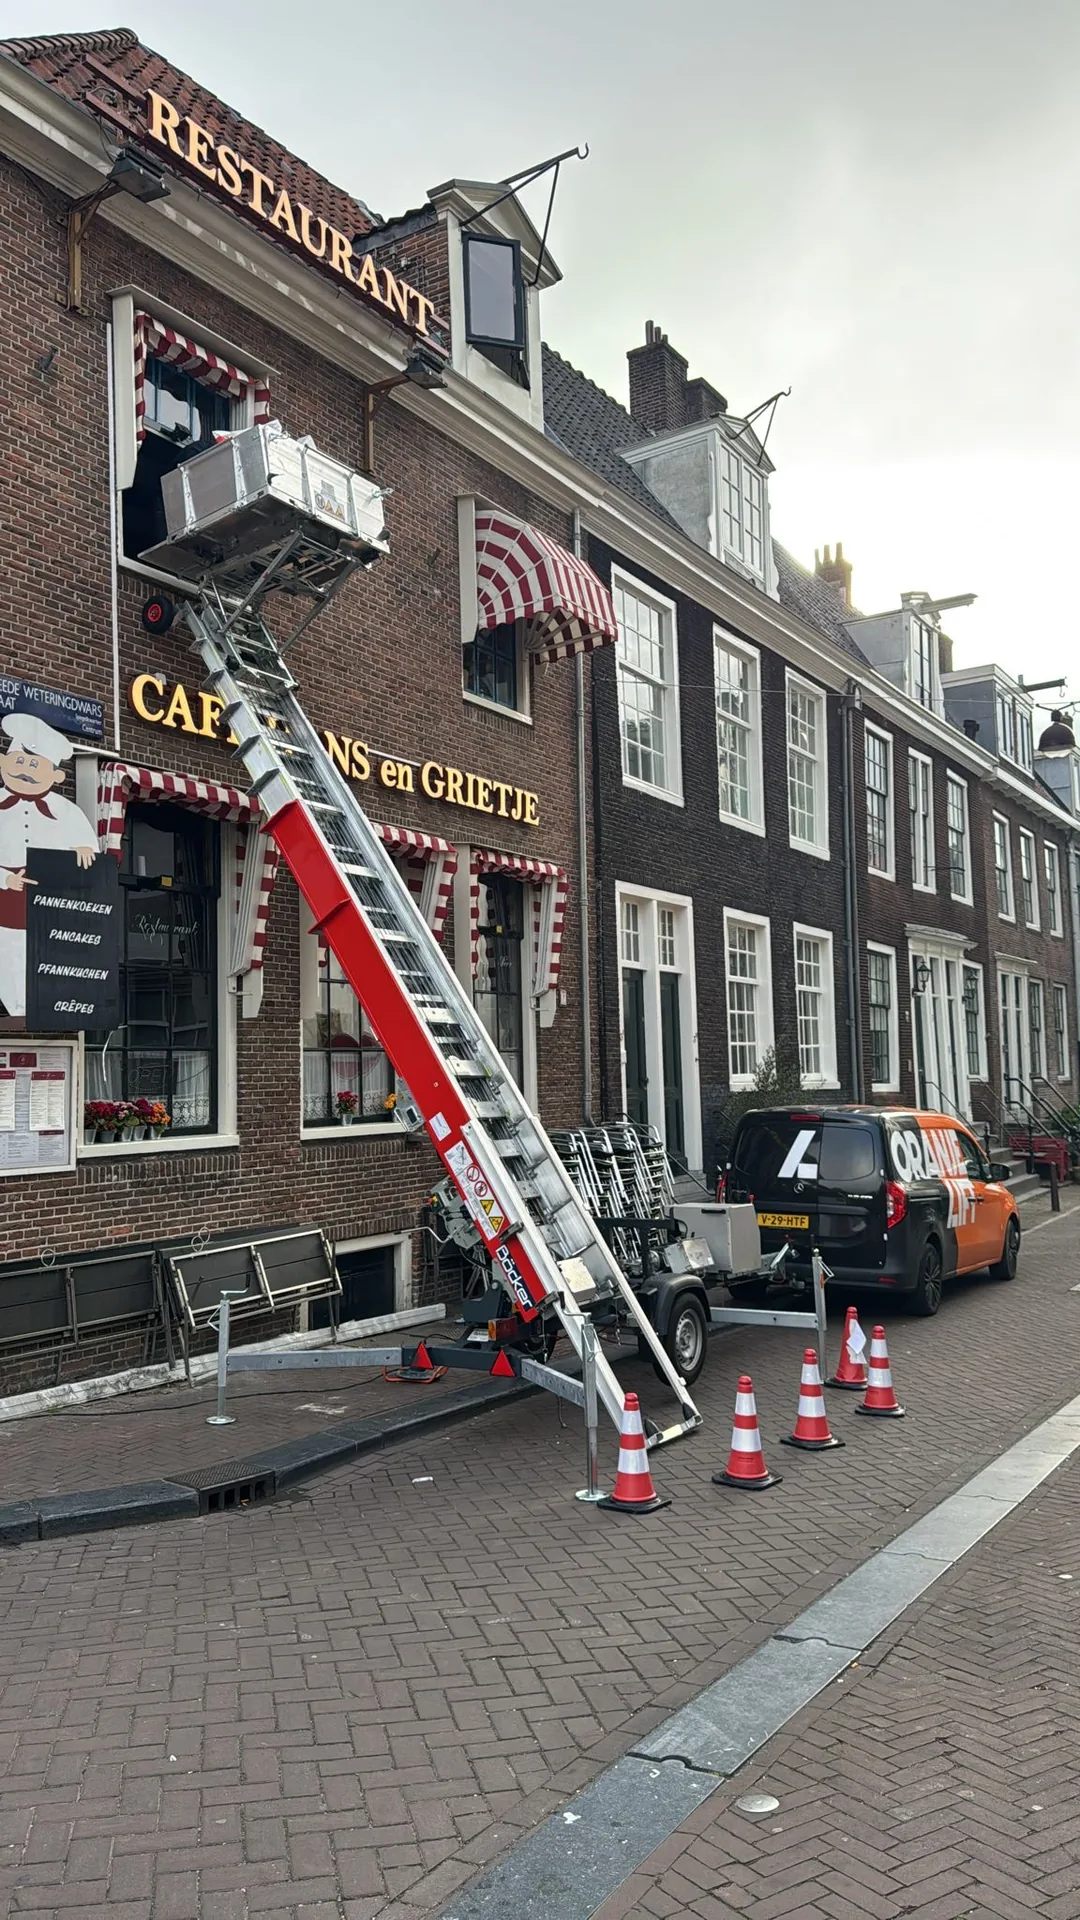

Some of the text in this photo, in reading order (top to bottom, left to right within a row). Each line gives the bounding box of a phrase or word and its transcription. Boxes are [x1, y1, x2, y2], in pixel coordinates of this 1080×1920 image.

[144, 88, 435, 337] RESTAURANT
[23, 685, 103, 718] WETERINGDWARS
[132, 674, 240, 746] CAF
[380, 760, 414, 793] en
[421, 761, 540, 827] GRIETJE
[33, 894, 113, 915] PANNENKOEKEN
[49, 928, 102, 945] PANCAKES
[37, 963, 109, 981] PFANNKUCHEN
[54, 999, 95, 1014] CRÊPES
[890, 1129, 969, 1182] ORANJE
[944, 1178, 976, 1228] LIFT
[761, 1214, 807, 1227] V-29-HTF
[495, 1245, 533, 1308] Böcker
